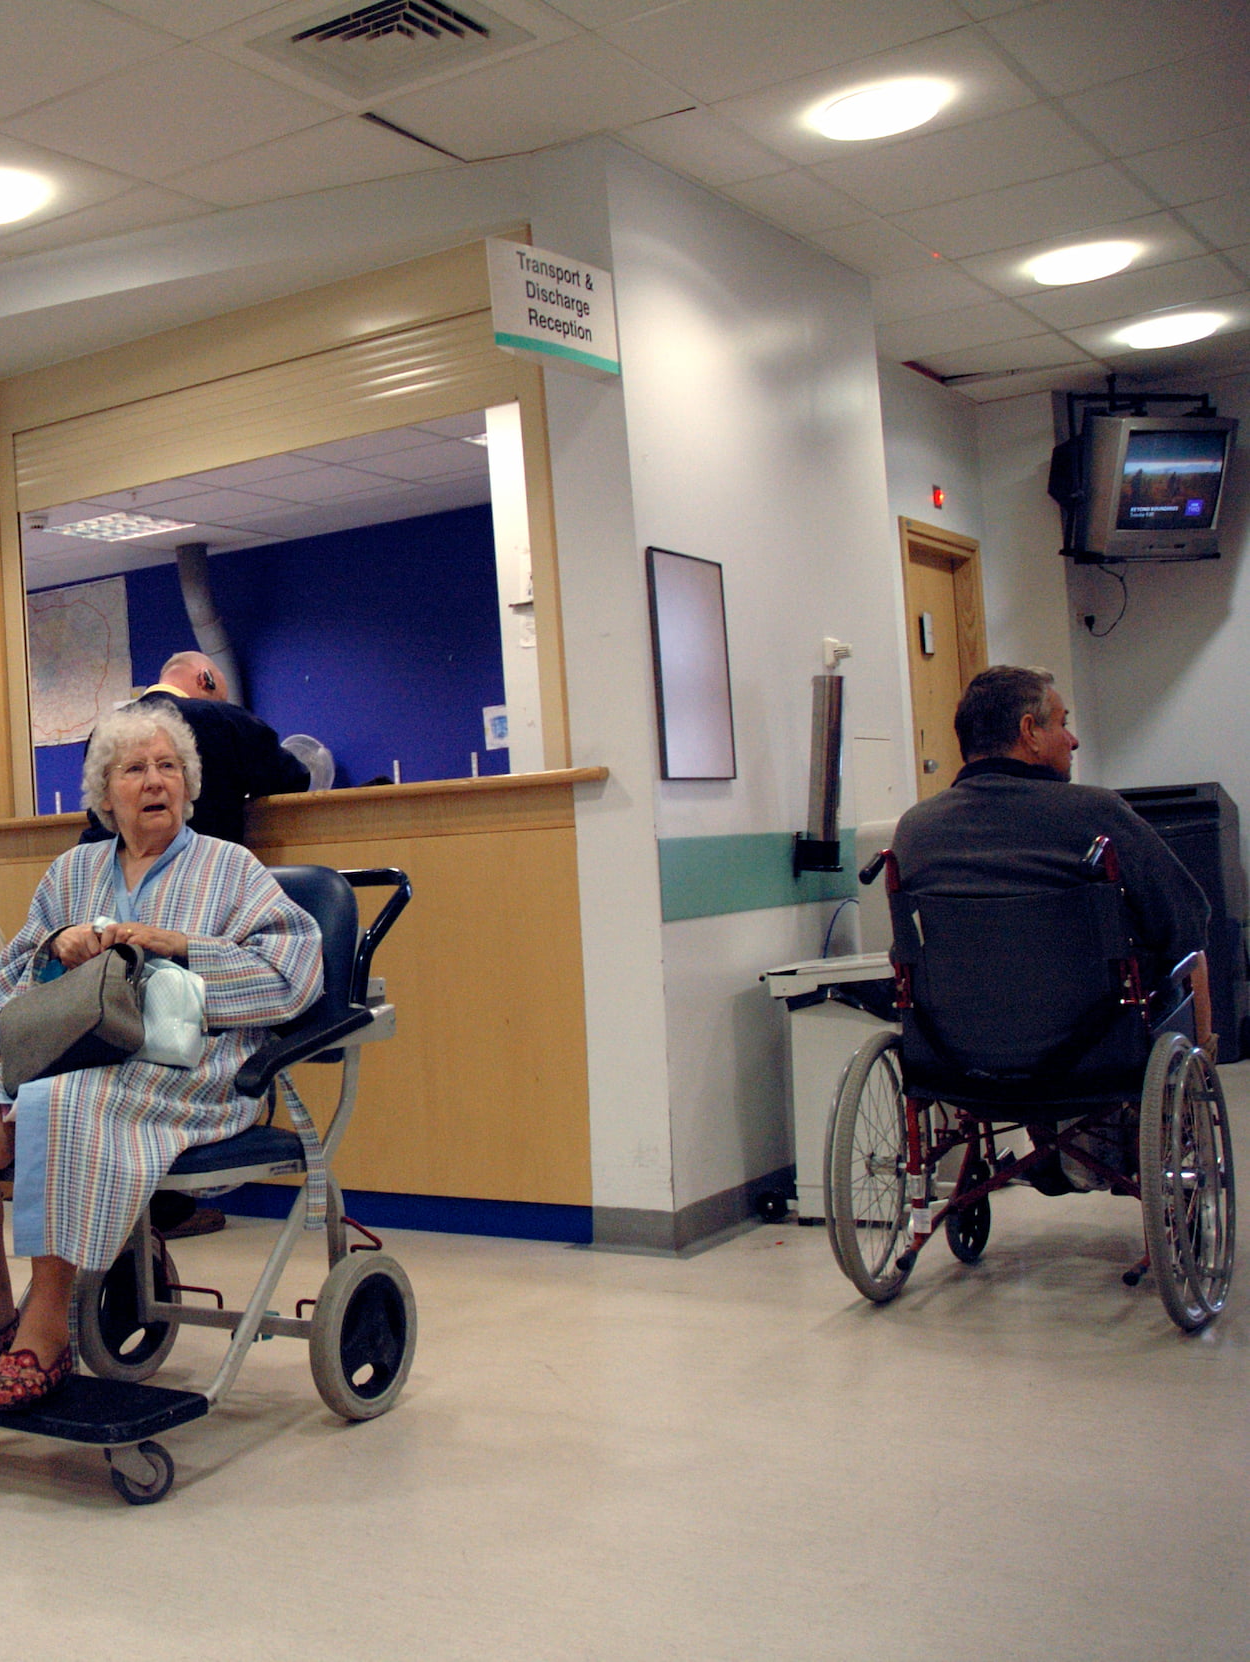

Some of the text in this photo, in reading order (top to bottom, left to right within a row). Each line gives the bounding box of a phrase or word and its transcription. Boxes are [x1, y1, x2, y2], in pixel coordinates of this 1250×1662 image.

[516, 251, 594, 291] Transport &
[525, 281, 590, 318] Discharge
[528, 308, 592, 342] Reception
